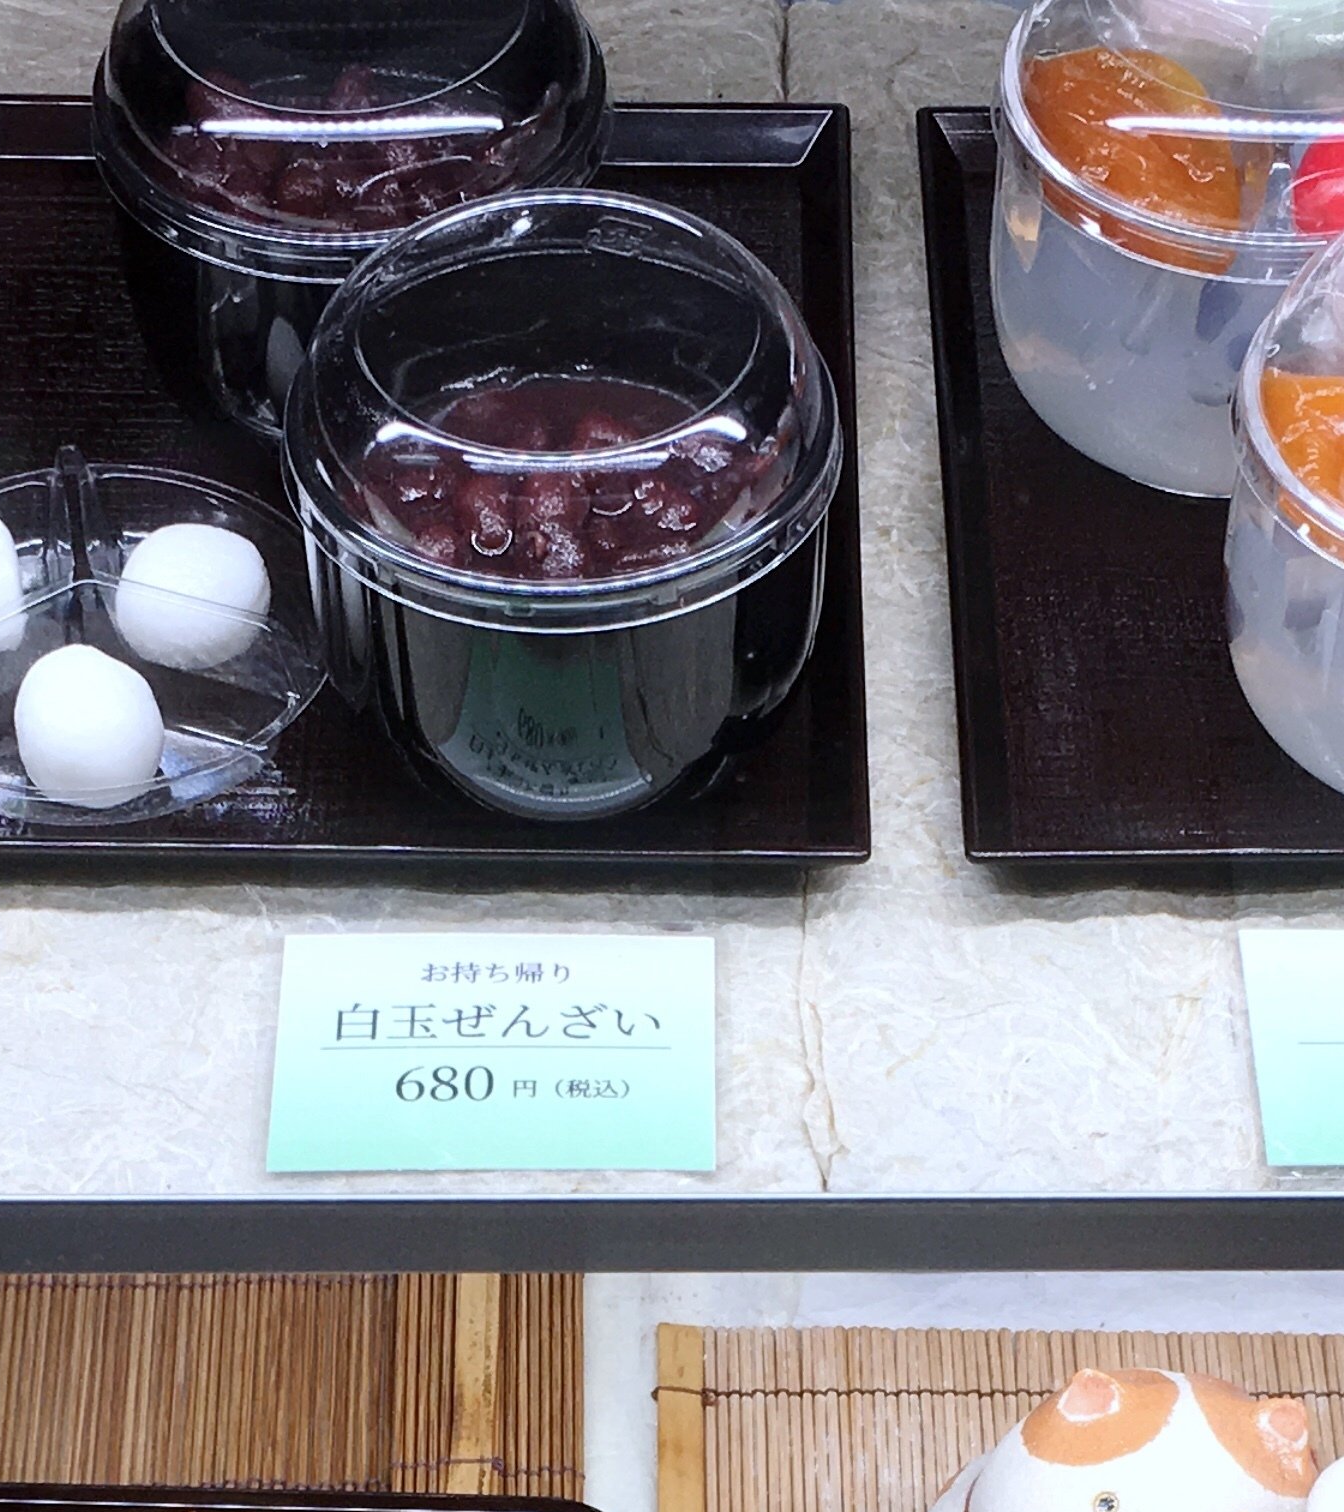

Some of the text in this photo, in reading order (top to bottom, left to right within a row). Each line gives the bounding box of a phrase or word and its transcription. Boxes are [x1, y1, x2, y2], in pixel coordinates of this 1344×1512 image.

[421, 962, 571, 984] お持ち帰り
[335, 1003, 661, 1041] 白玉ぜんざい
[395, 1065, 494, 1102] 680
